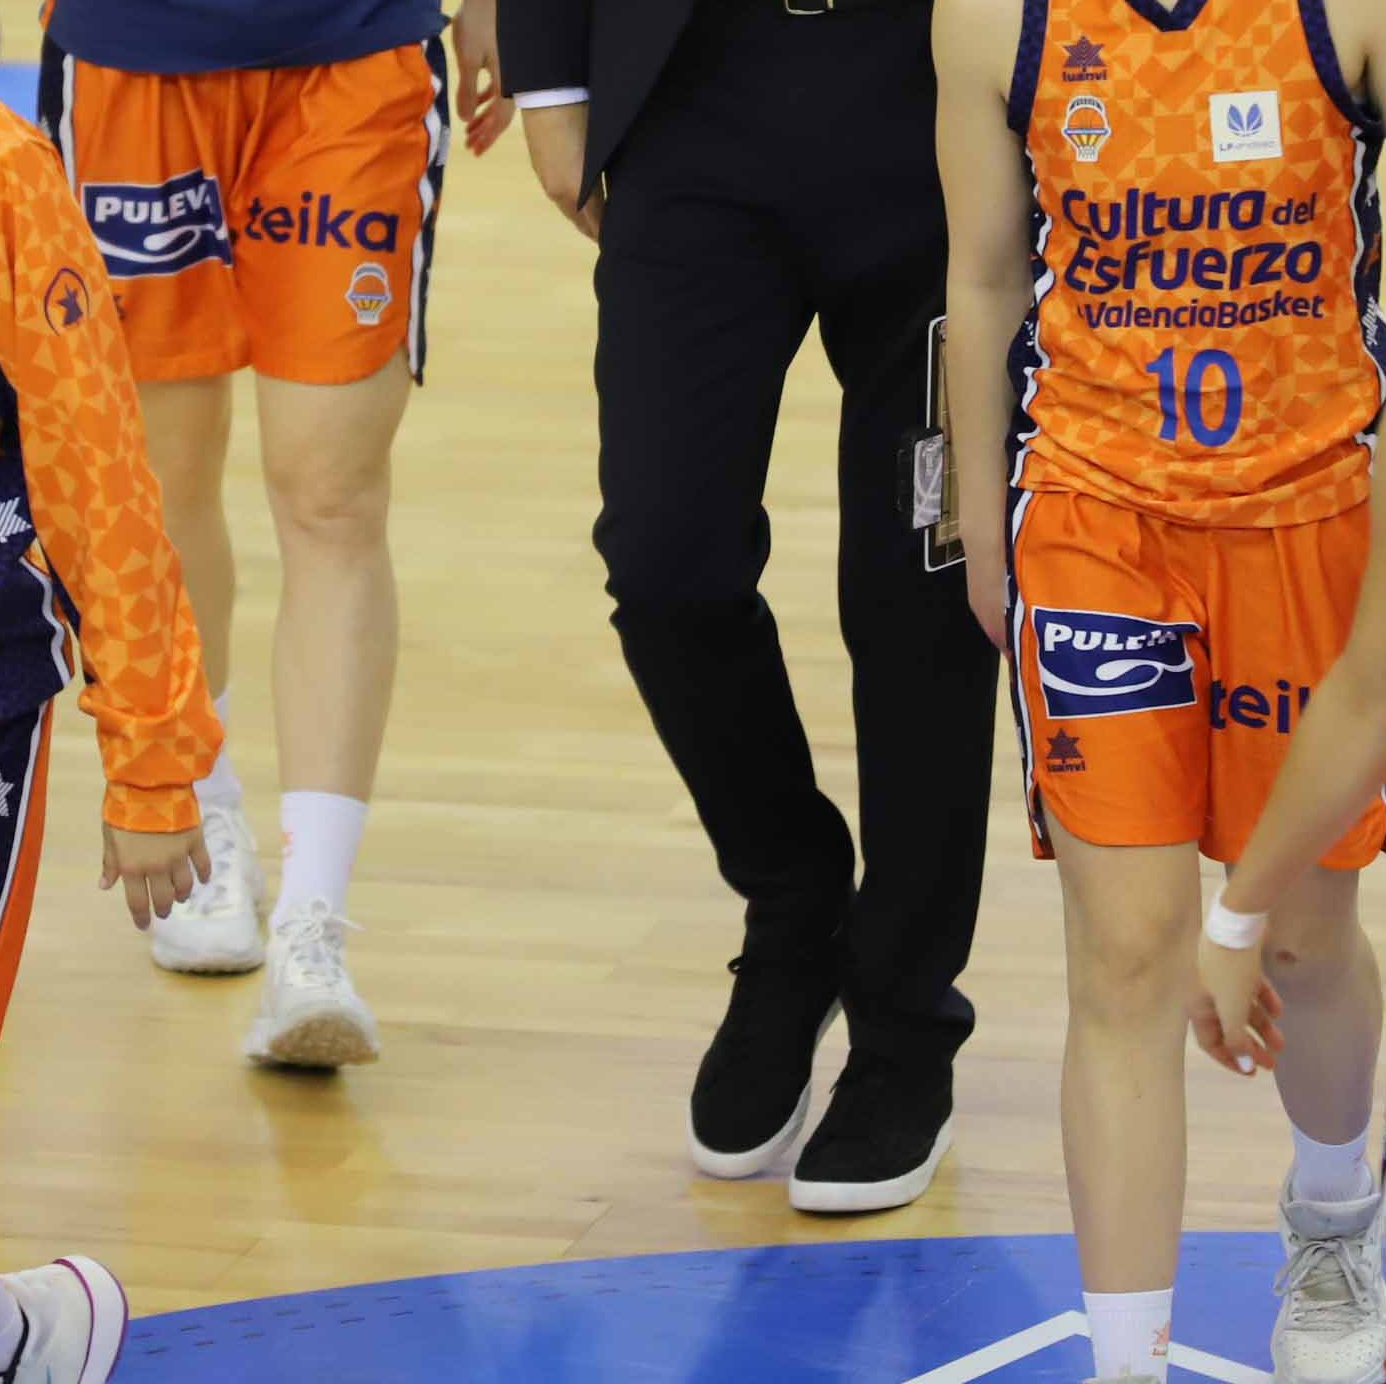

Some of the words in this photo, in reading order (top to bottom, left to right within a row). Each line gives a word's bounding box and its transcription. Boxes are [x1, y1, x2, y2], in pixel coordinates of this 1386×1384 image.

[244, 190, 401, 253] teika
[1062, 188, 1266, 240] Cultura
[1271, 192, 1317, 226] del
[1065, 236, 1323, 294] Esfuerzo
[1078, 290, 1324, 329] ValenciaBasket
[1144, 346, 1244, 448] 10
